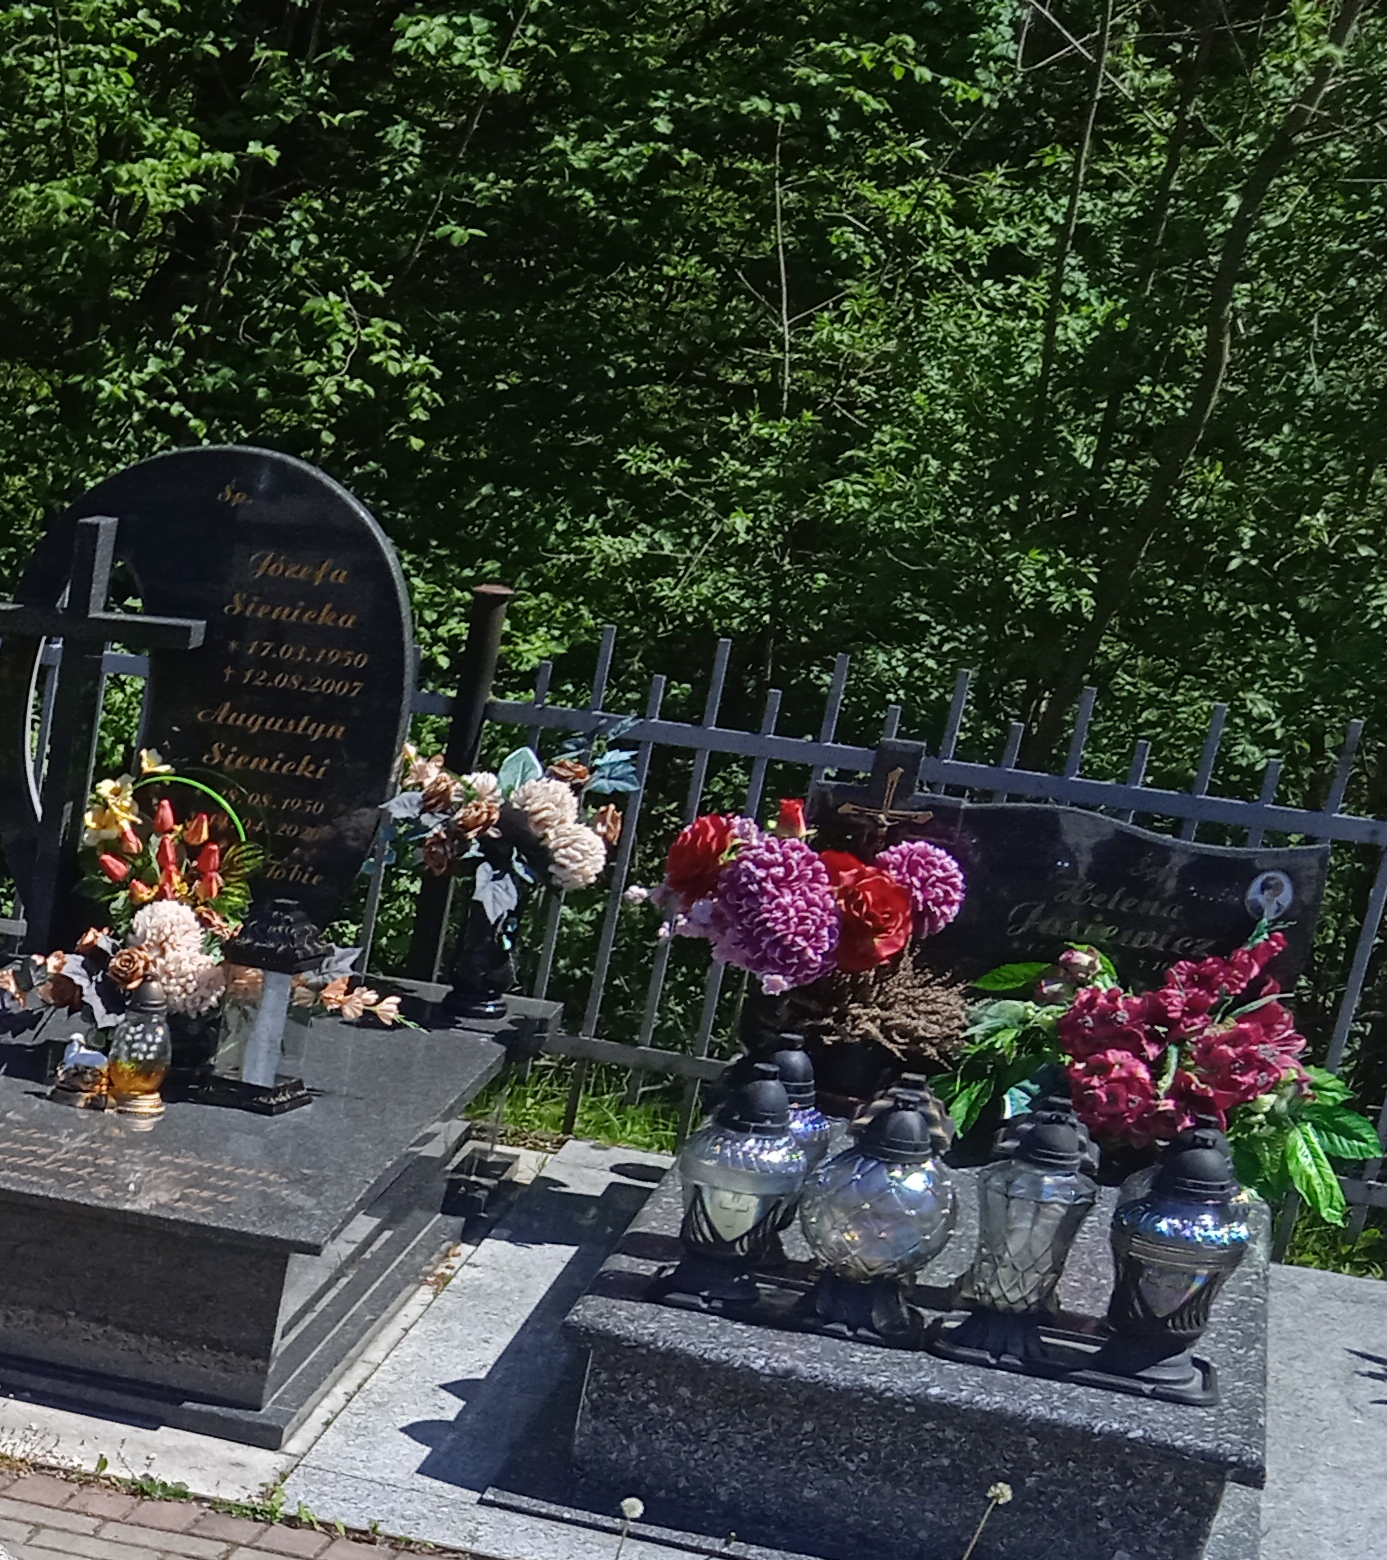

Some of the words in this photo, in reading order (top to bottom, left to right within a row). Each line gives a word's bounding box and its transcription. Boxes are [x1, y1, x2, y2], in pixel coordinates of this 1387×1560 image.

[249, 552, 349, 586] Józefa
[223, 593, 358, 629] Sienicka
[241, 668, 365, 698] 12.08.2007
[196, 701, 346, 742] Augustyn
[201, 740, 332, 781] Sienicki
